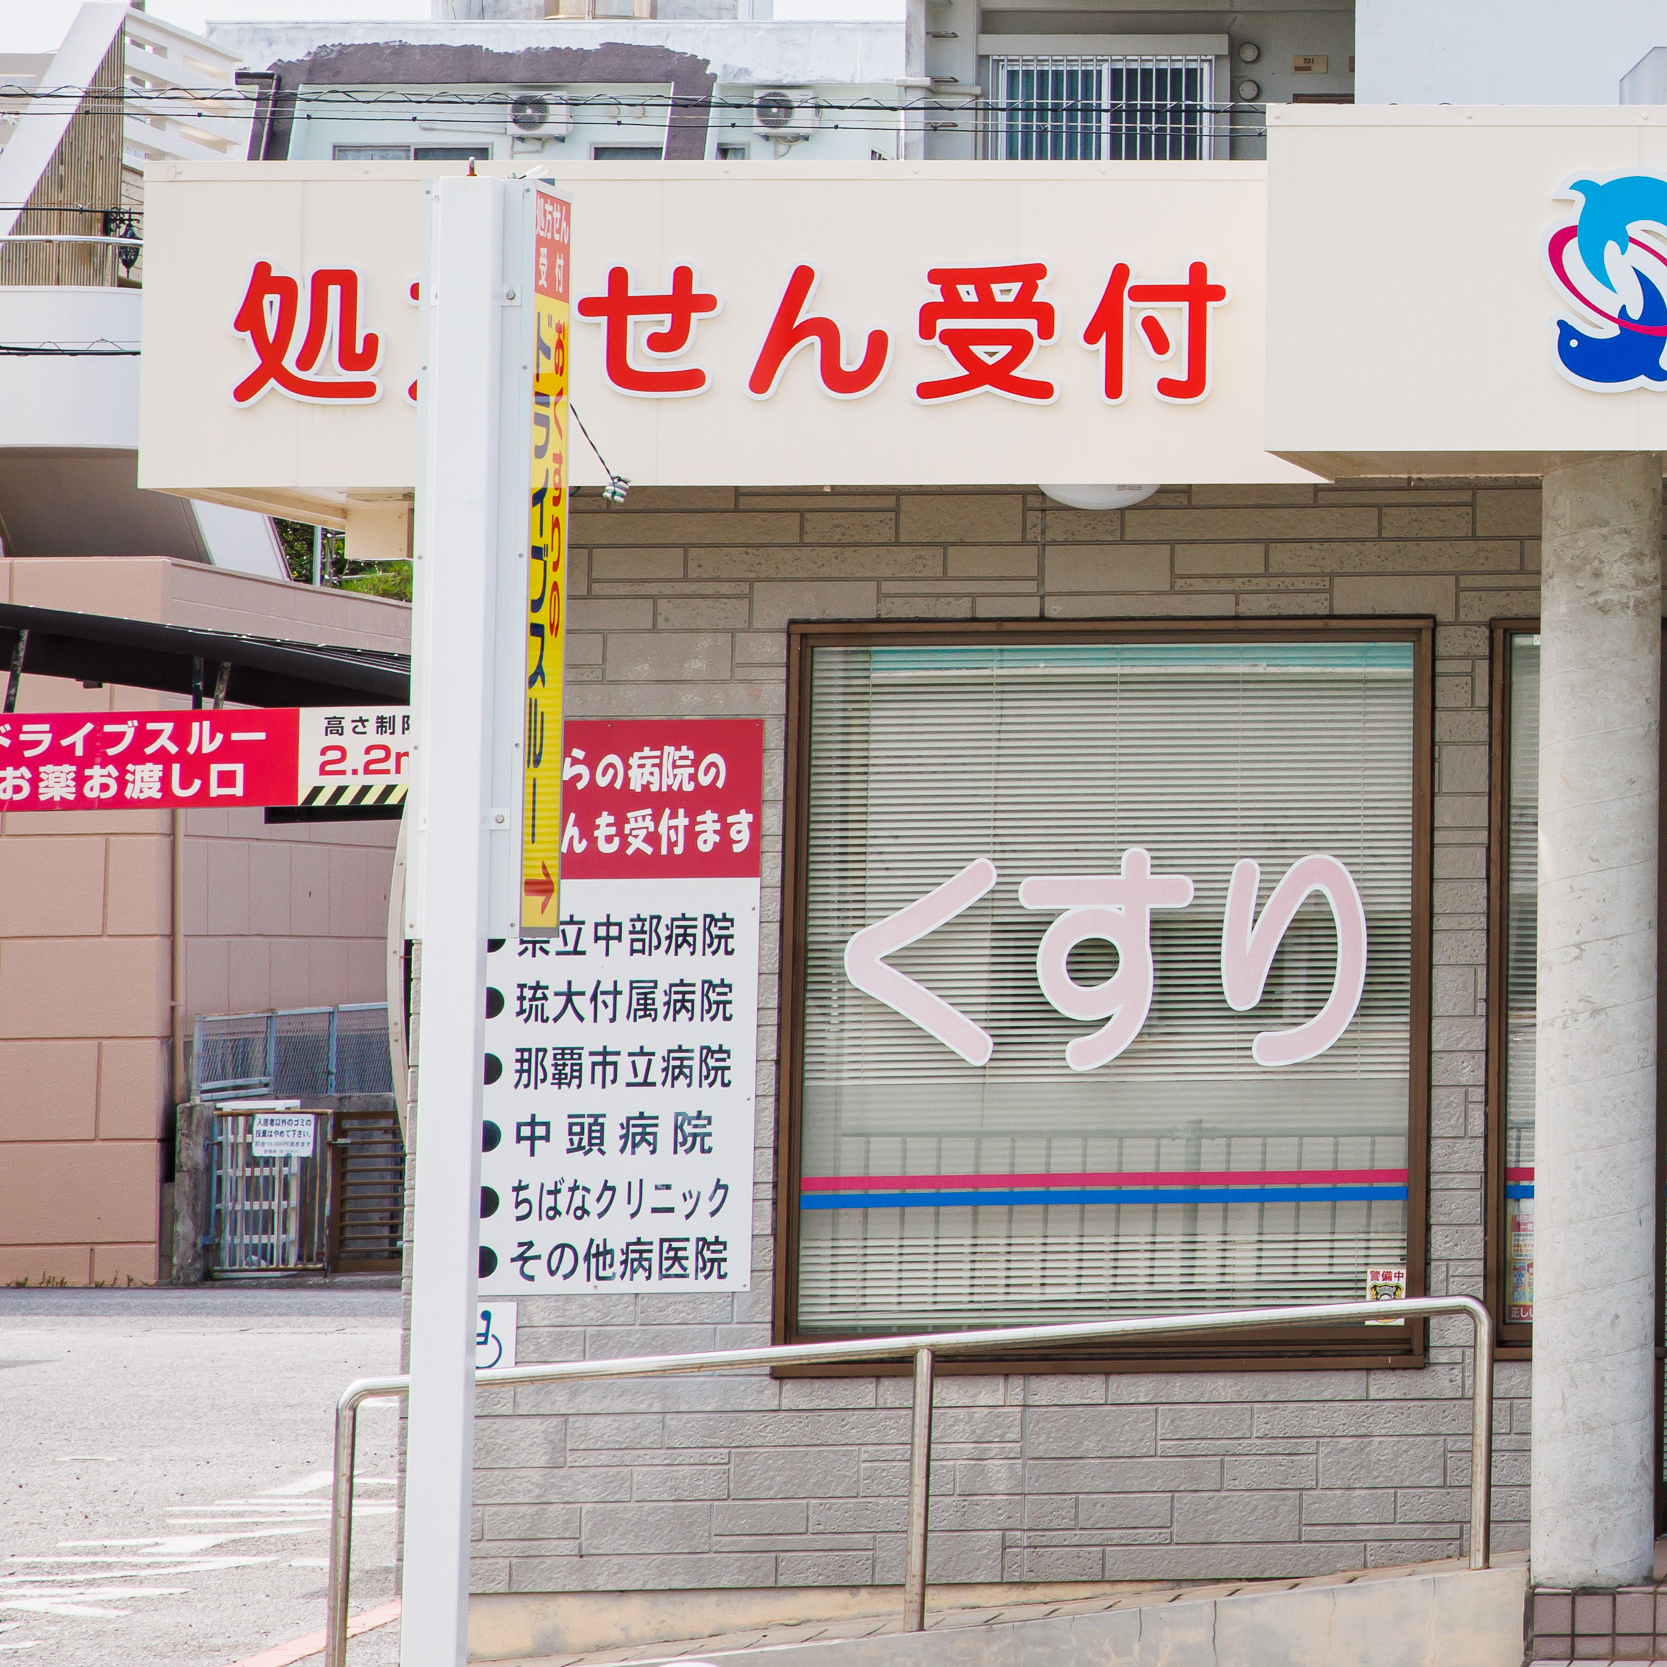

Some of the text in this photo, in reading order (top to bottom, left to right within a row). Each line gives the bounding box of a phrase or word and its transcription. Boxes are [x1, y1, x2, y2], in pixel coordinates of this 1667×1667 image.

[536, 193, 570, 245] 処方せん
[538, 247, 565, 294] 受付
[230, 258, 1230, 406] 処せん受付
[548, 320, 567, 639] おくすりの
[526, 311, 553, 844] ドライブスルー
[0, 762, 244, 802] お薬お渡し口
[844, 847, 1368, 1072] くすり
[515, 977, 734, 1024] 琉大付属病院
[513, 1043, 732, 1090] 那覇市立病院
[515, 1110, 713, 1158] 中頭病院
[511, 1177, 730, 1222] ちばなクリニック
[510, 1235, 729, 1282] その他病医院
[1369, 1270, 1404, 1282] 警備中
